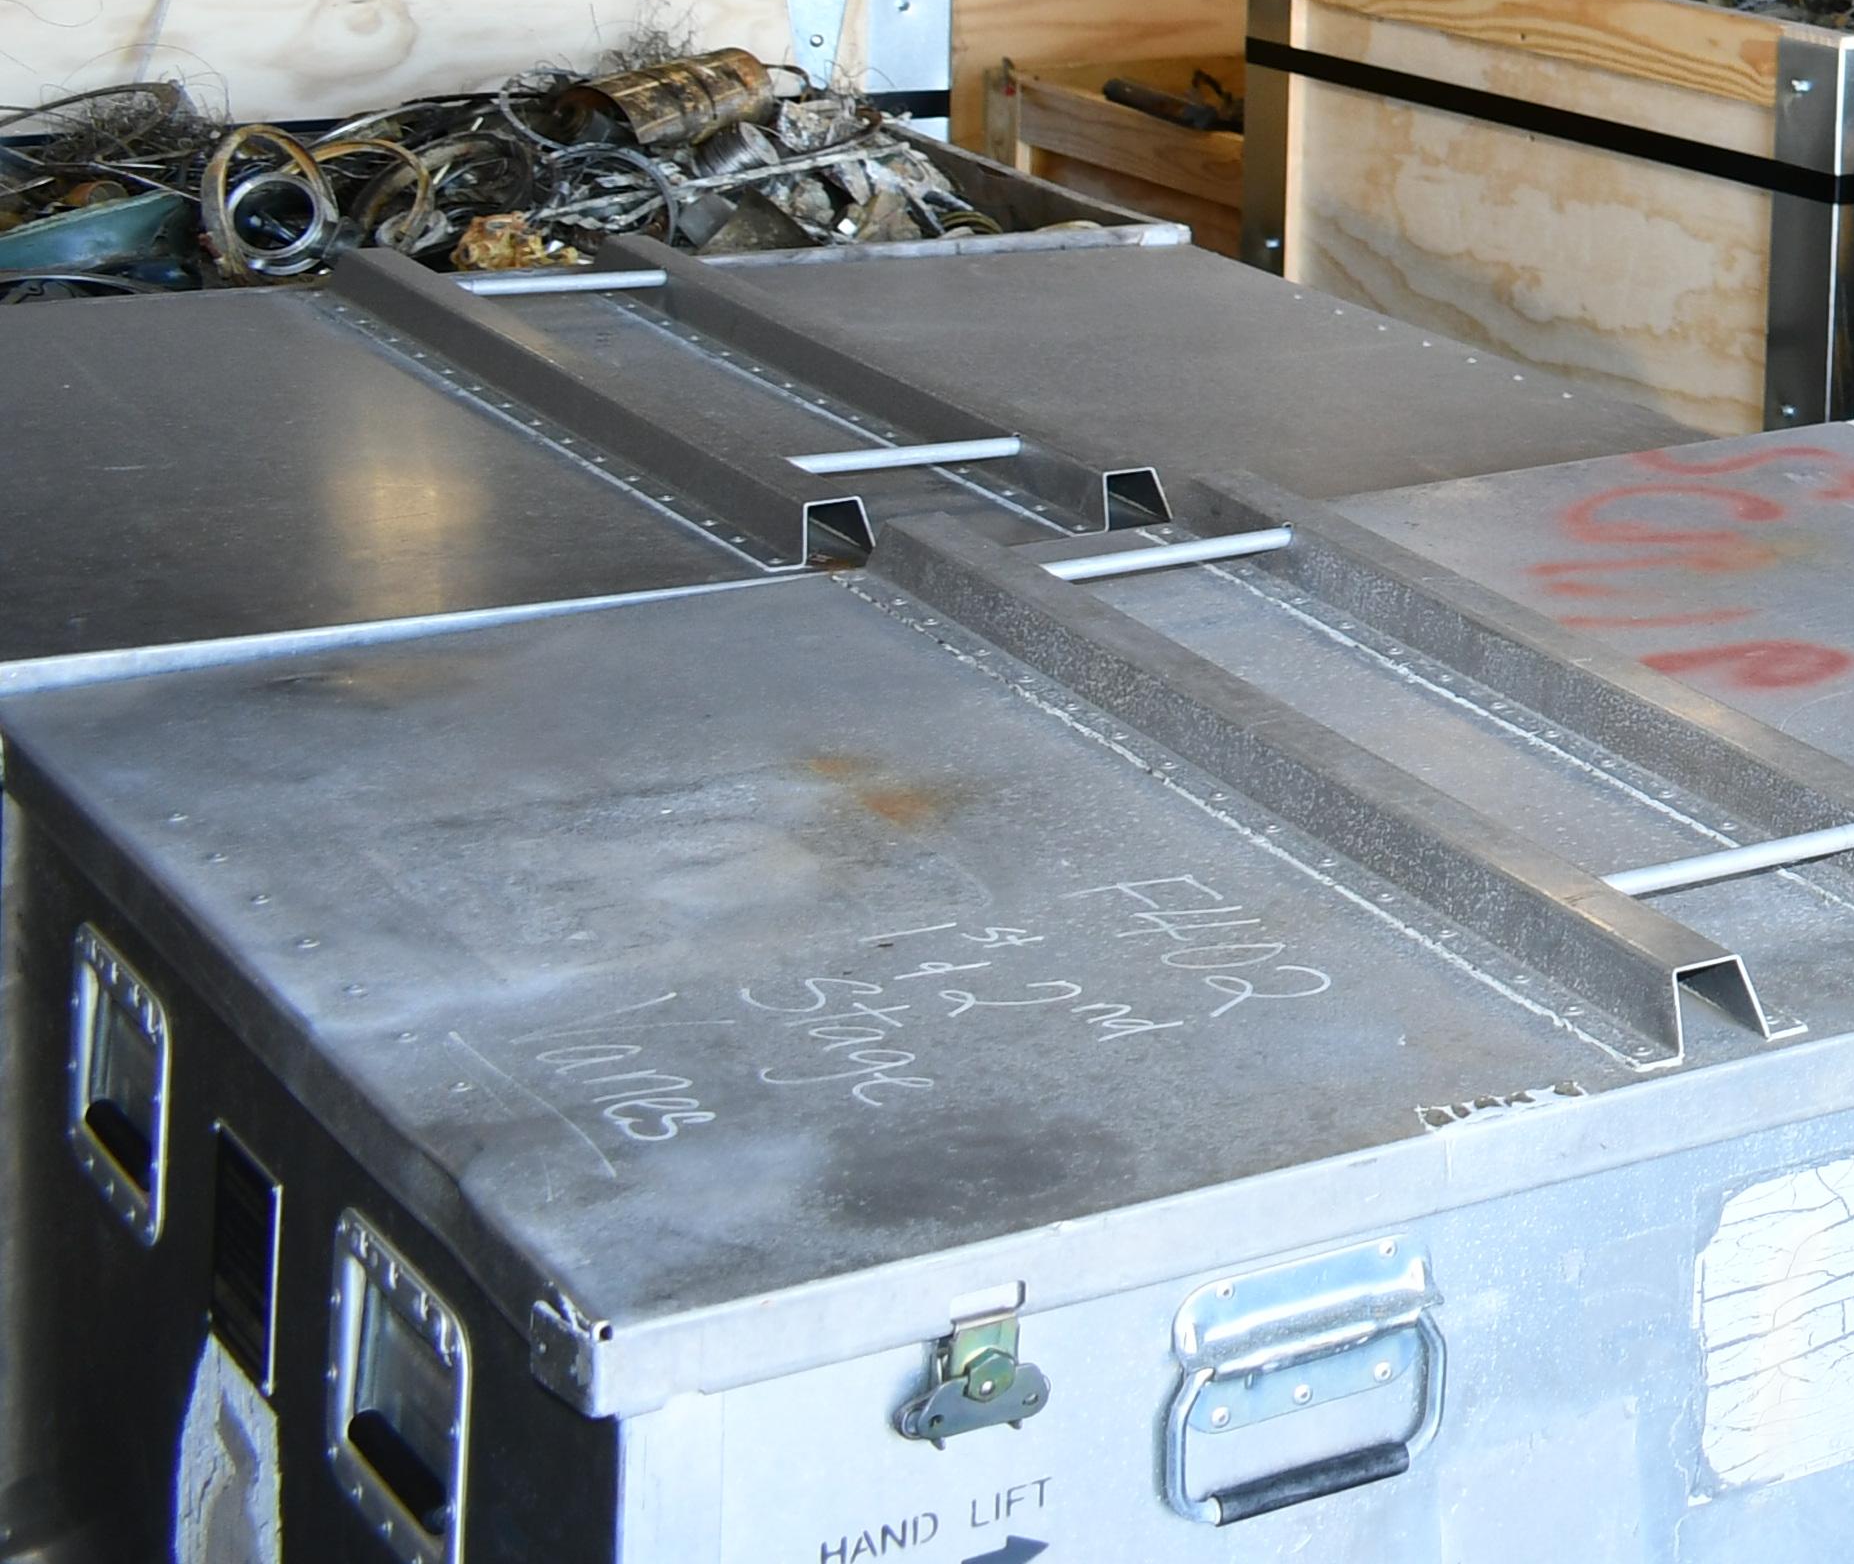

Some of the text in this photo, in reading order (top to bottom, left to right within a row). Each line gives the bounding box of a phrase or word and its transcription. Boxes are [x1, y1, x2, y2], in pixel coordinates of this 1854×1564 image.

[509, 991, 736, 1142] Vanes
[740, 978, 935, 1107] Stage
[820, 1476, 1053, 1564] HAND LIFT
